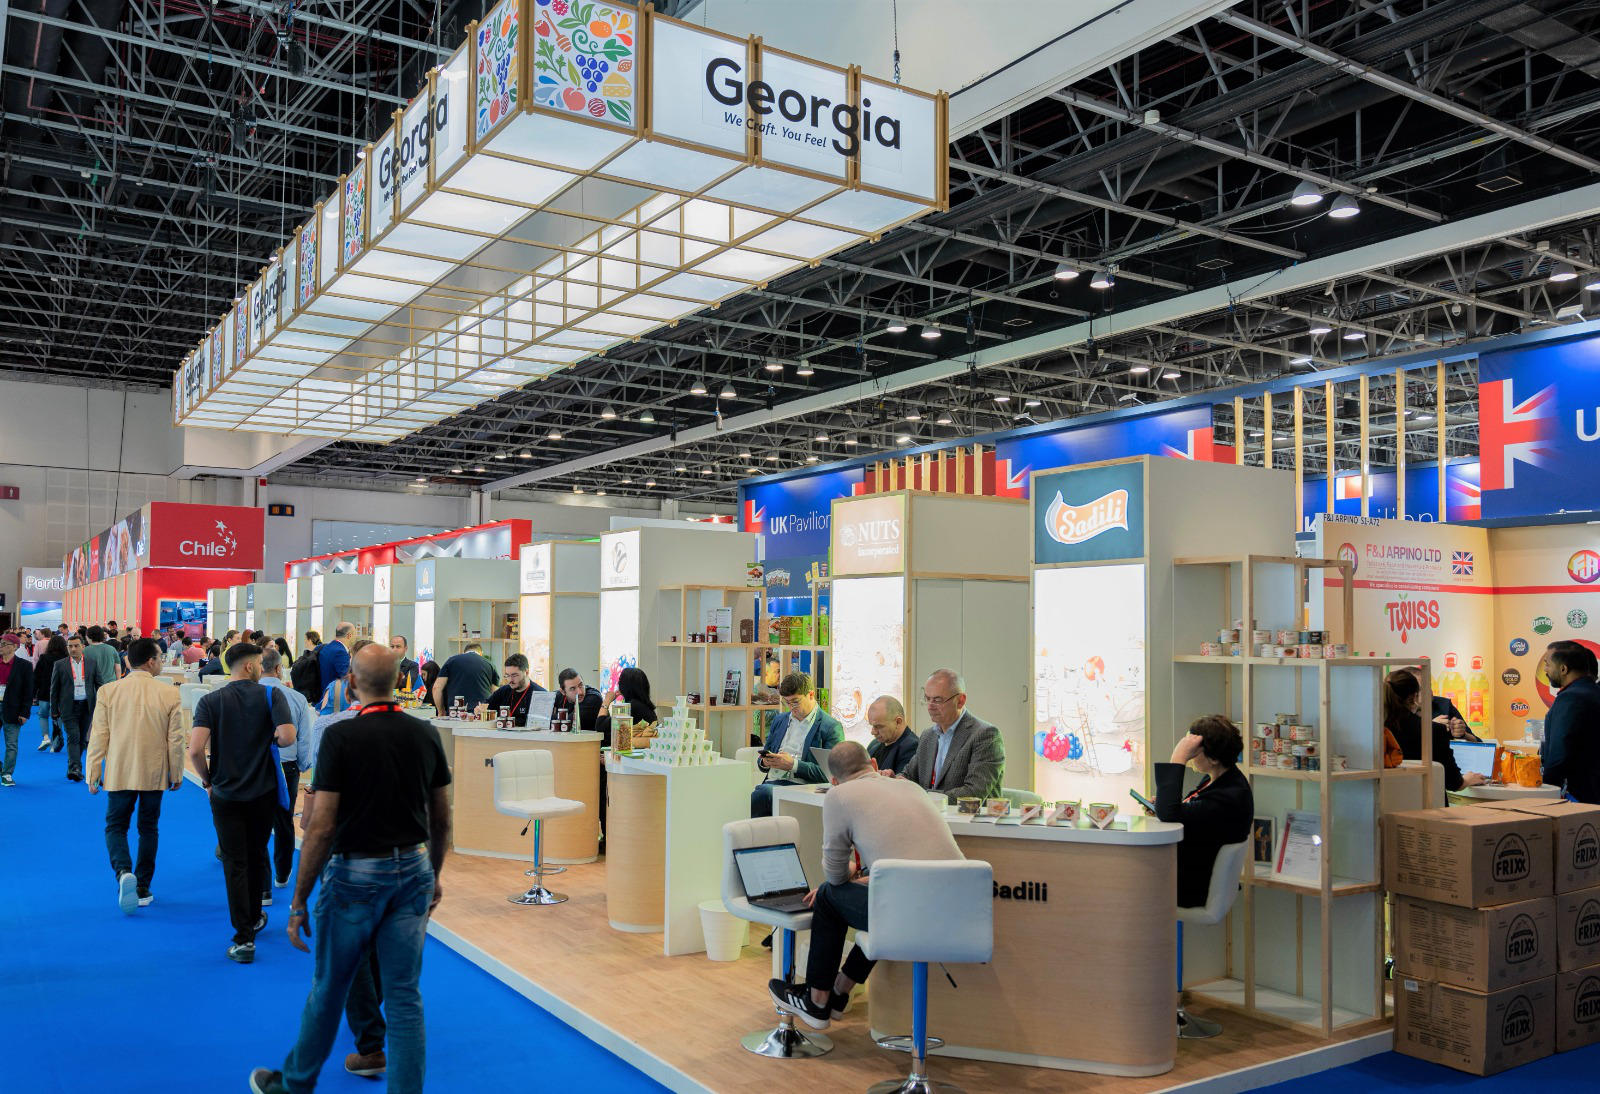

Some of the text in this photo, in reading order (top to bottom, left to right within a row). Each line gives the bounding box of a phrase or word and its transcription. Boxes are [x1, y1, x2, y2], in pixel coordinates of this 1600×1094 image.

[705, 57, 901, 157] Georgia
[724, 111, 828, 148] We Craft. You Feel
[380, 93, 448, 189] Georgia
[254, 266, 287, 320] Georgia
[770, 515, 788, 535] UK
[1058, 498, 1124, 539] Sadili
[1323, 513, 1380, 527] F&J ARPINO S1-A72
[858, 518, 900, 542] NUTS
[179, 540, 227, 557] Chile
[1366, 543, 1385, 559] F&J
[1386, 546, 1423, 561] ARPINO
[1424, 548, 1442, 563] LTD
[1575, 846, 1598, 864] FRIXX
[1496, 857, 1526, 877] FRIXX
[1578, 922, 1600, 941] FRIX
[1508, 938, 1536, 959] FRIXX
[1577, 999, 1600, 1019] FRIX
[1504, 1018, 1531, 1040] FRIXX
